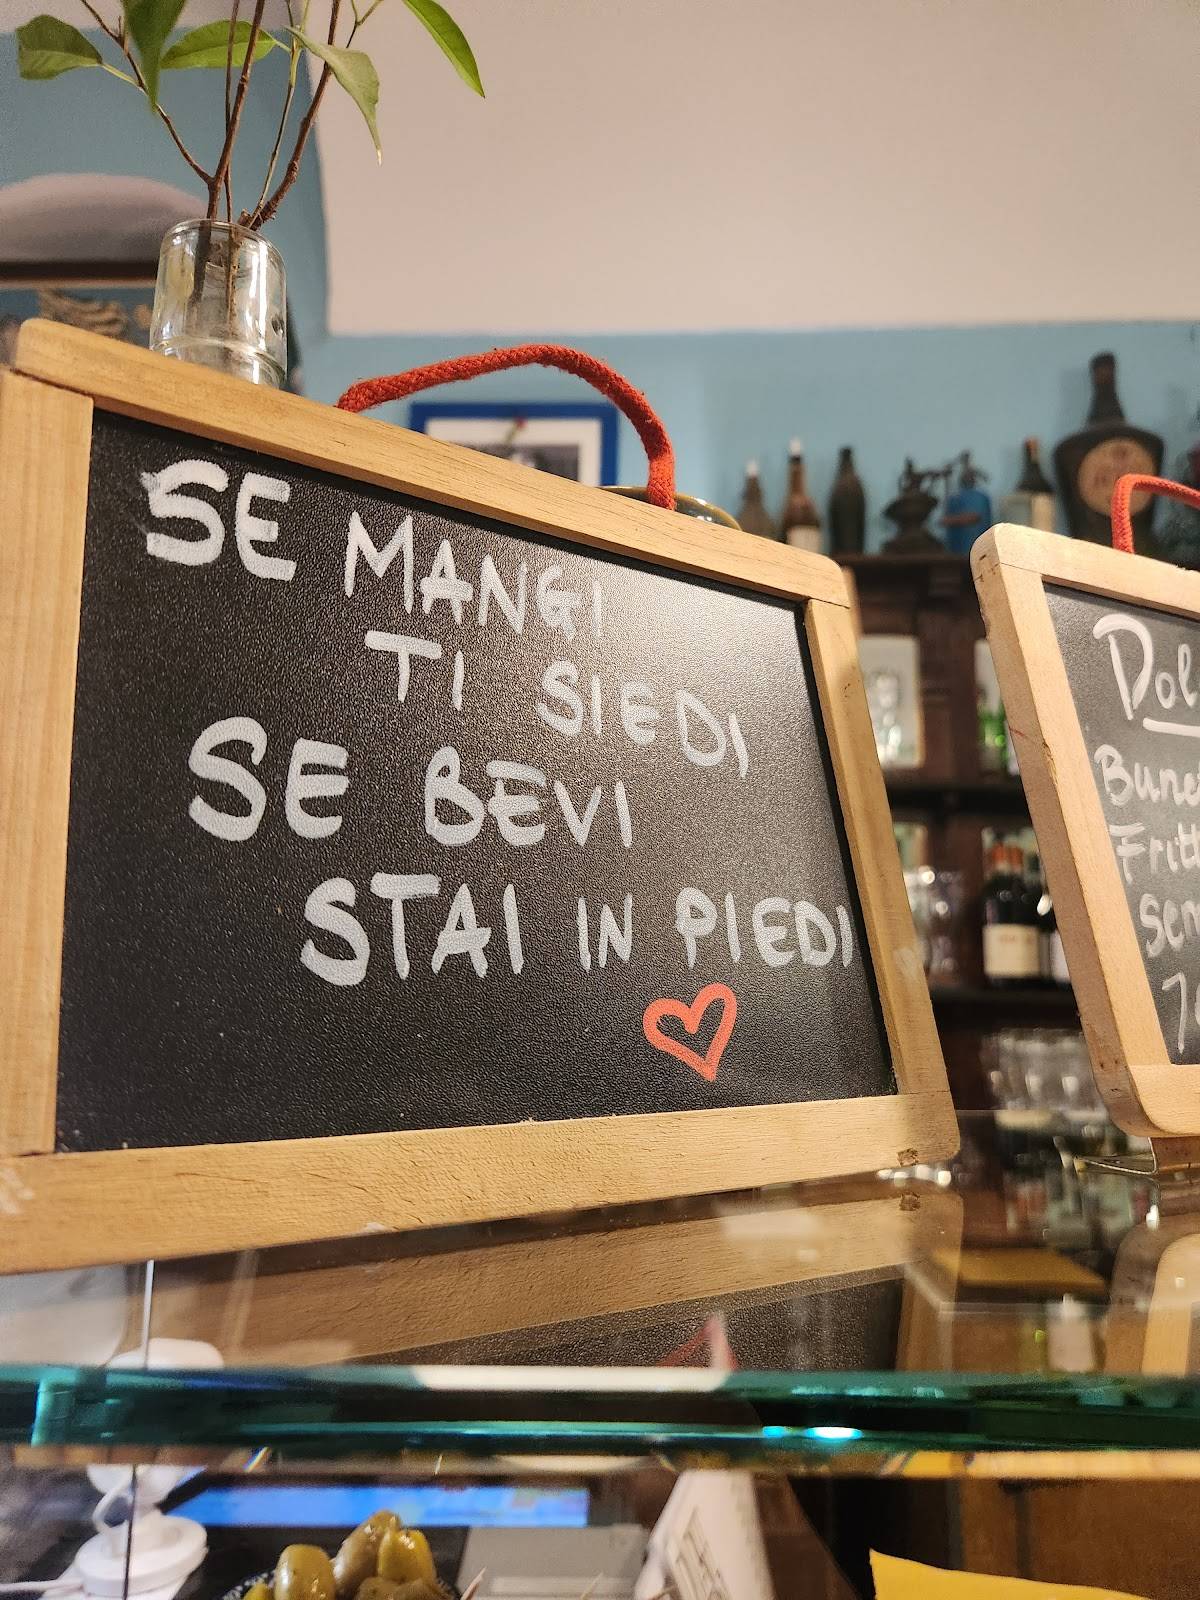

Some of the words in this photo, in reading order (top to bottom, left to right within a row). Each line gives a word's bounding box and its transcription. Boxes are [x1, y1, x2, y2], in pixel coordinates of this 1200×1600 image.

[140, 459, 296, 580] SE
[345, 511, 602, 639] MANGI
[365, 630, 464, 711] TI
[536, 659, 749, 779] SIEDI
[188, 716, 350, 841] SE
[425, 745, 632, 848] BEVI
[300, 872, 524, 986] STAI
[577, 893, 633, 973] IN
[675, 887, 853, 969] PIEDI
